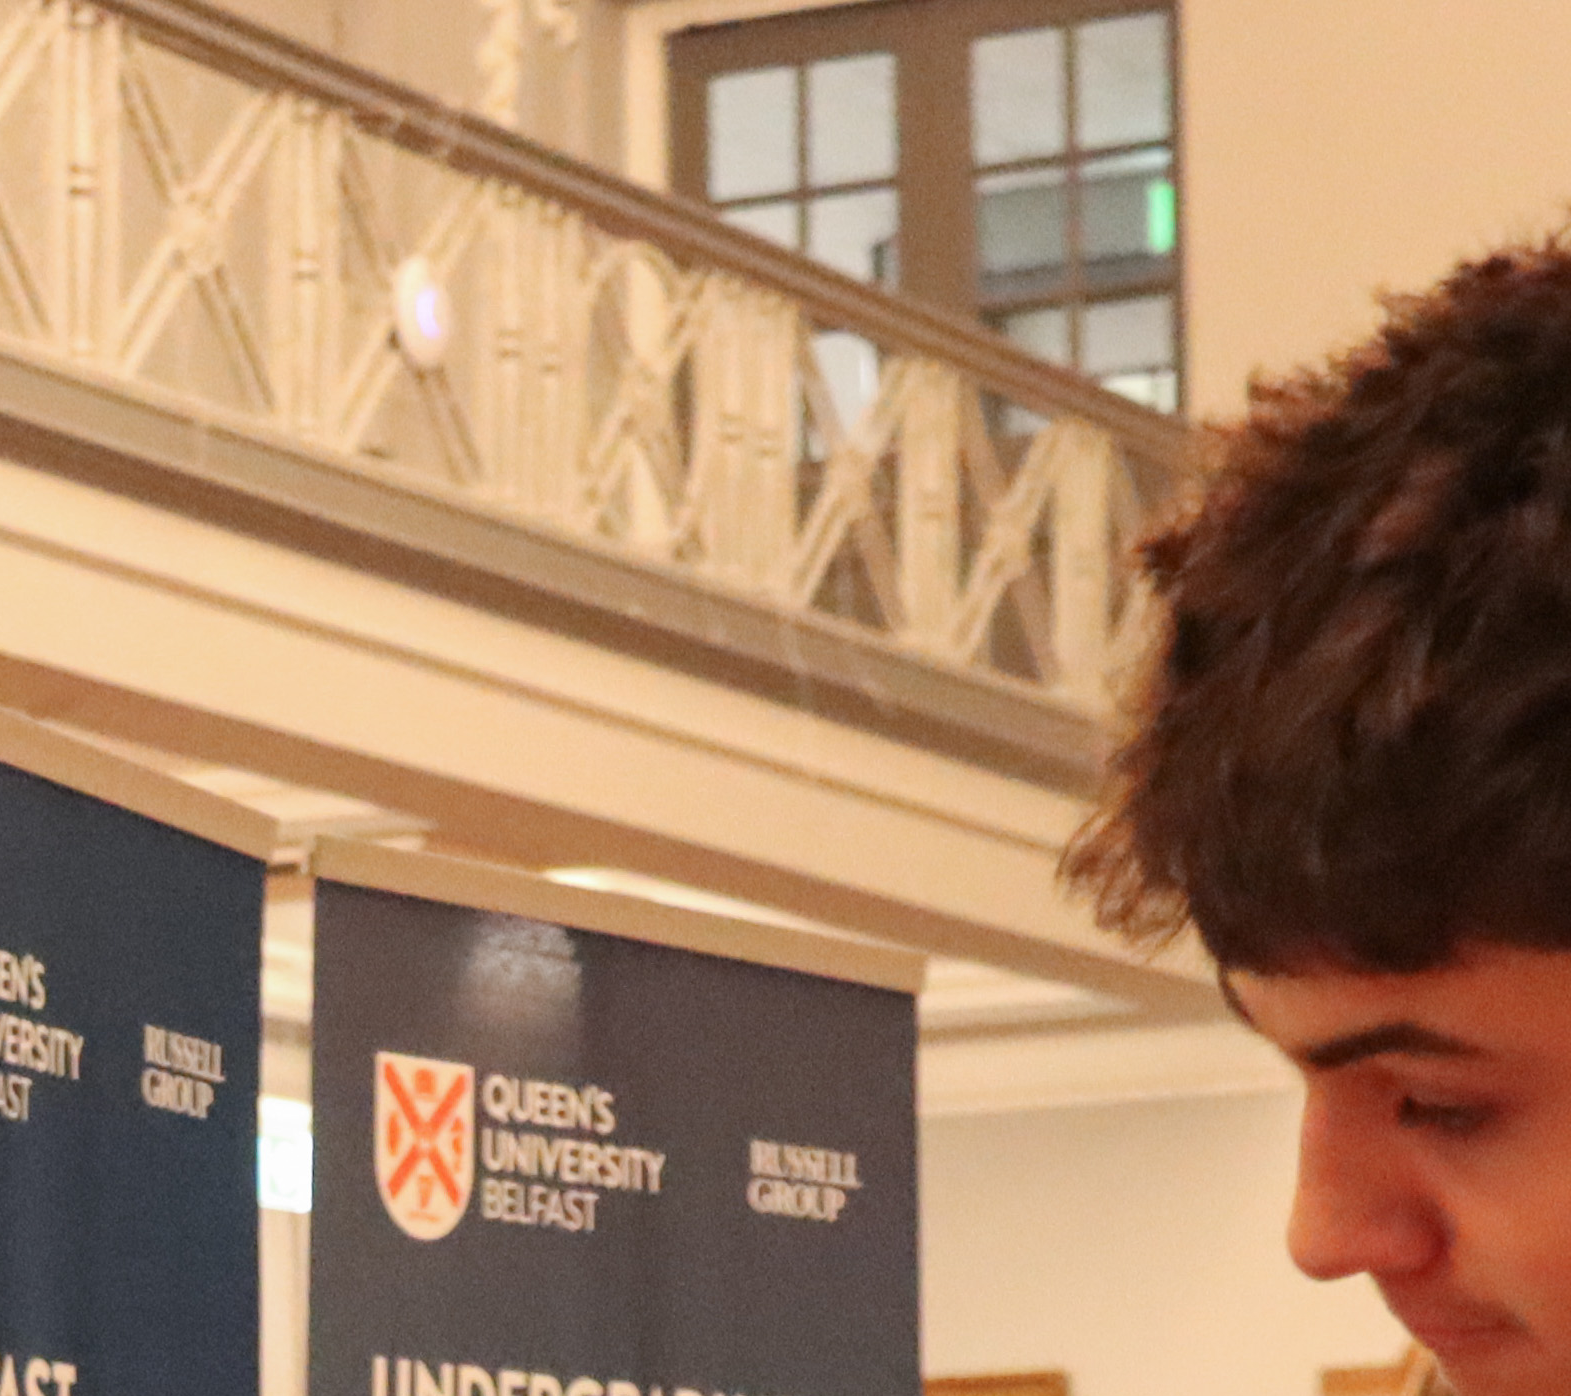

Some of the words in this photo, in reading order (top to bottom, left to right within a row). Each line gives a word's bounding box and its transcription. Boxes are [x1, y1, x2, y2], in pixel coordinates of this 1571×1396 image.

[144, 1024, 225, 1082] RUSSELL
[141, 1068, 215, 1120] GROUP
[482, 1073, 614, 1134] QUEEN'S
[482, 1128, 664, 1192] UNIVERSITY
[750, 1140, 862, 1188] RUSSELL
[482, 1177, 598, 1231] BELFAST
[748, 1180, 846, 1222] GROUP
